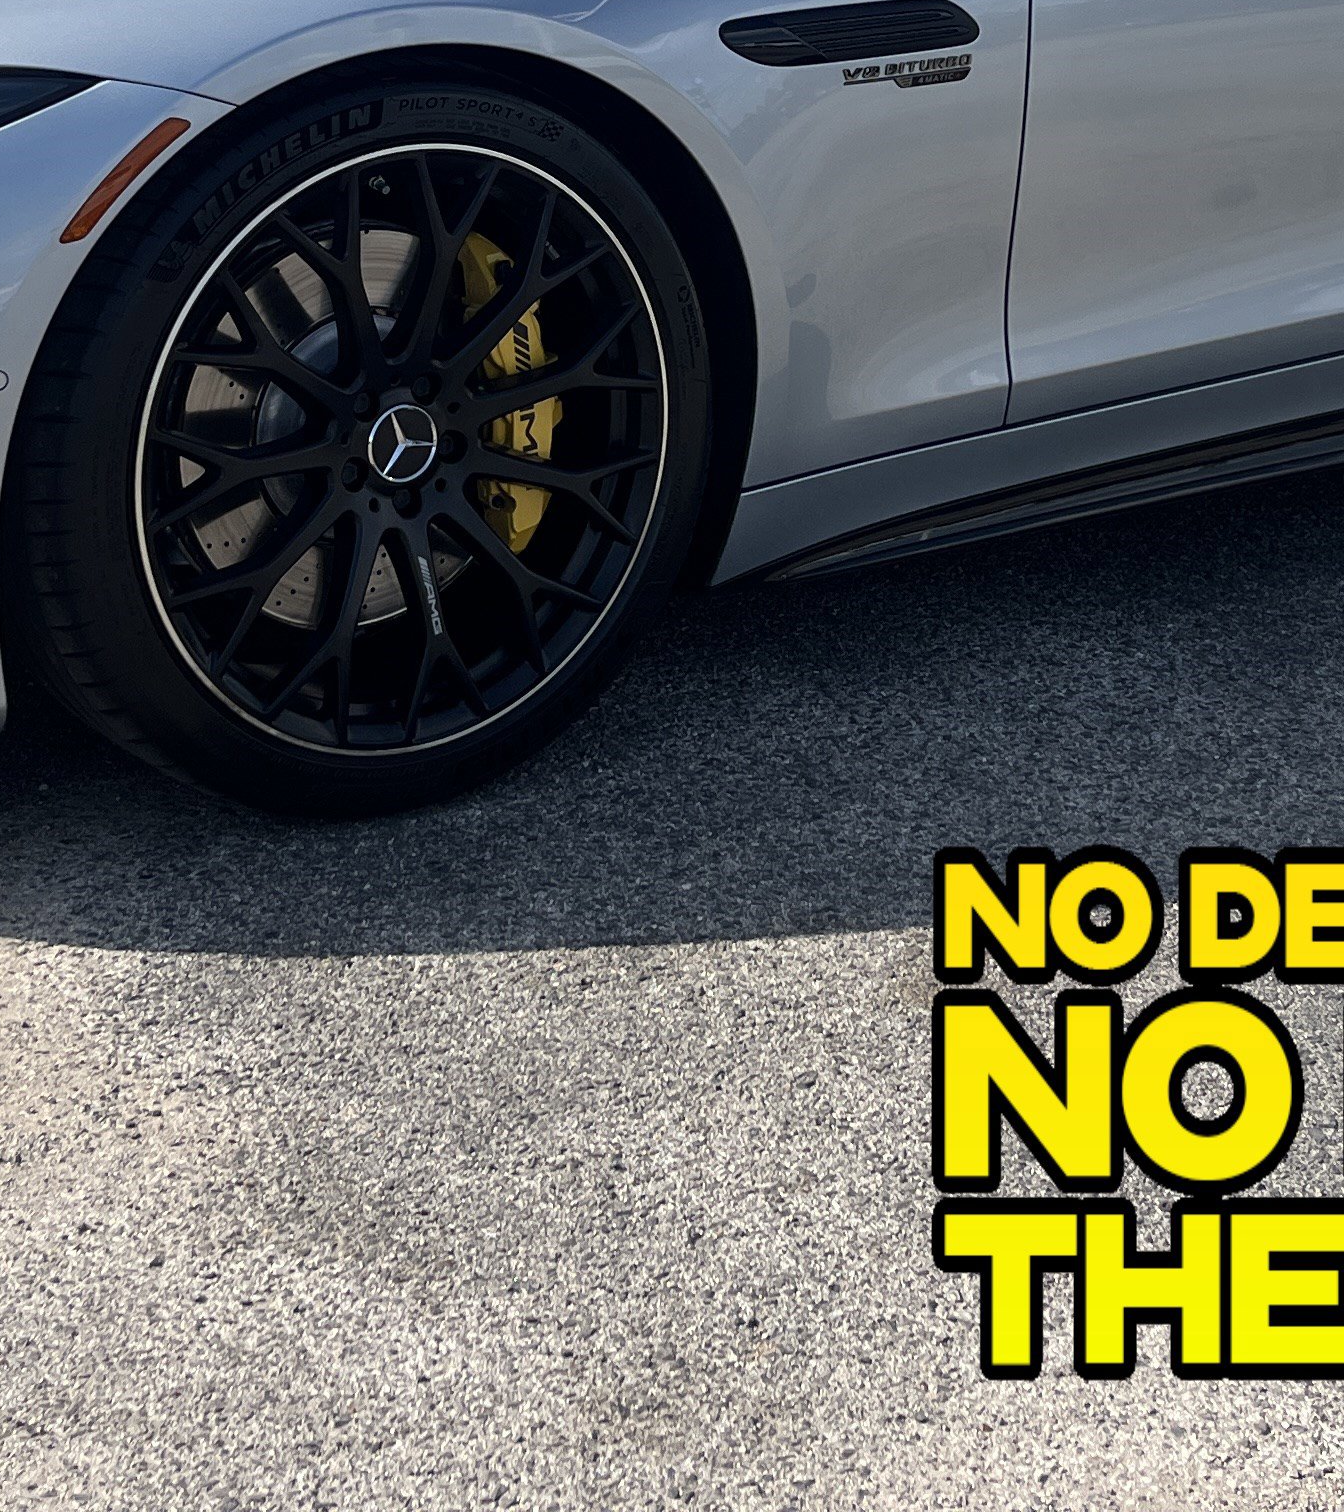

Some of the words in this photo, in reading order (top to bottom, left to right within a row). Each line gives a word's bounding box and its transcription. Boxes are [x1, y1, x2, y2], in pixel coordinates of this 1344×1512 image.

[885, 54, 973, 76] BITURBO
[192, 99, 374, 235] MICHELIN
[399, 96, 450, 112] PILOT
